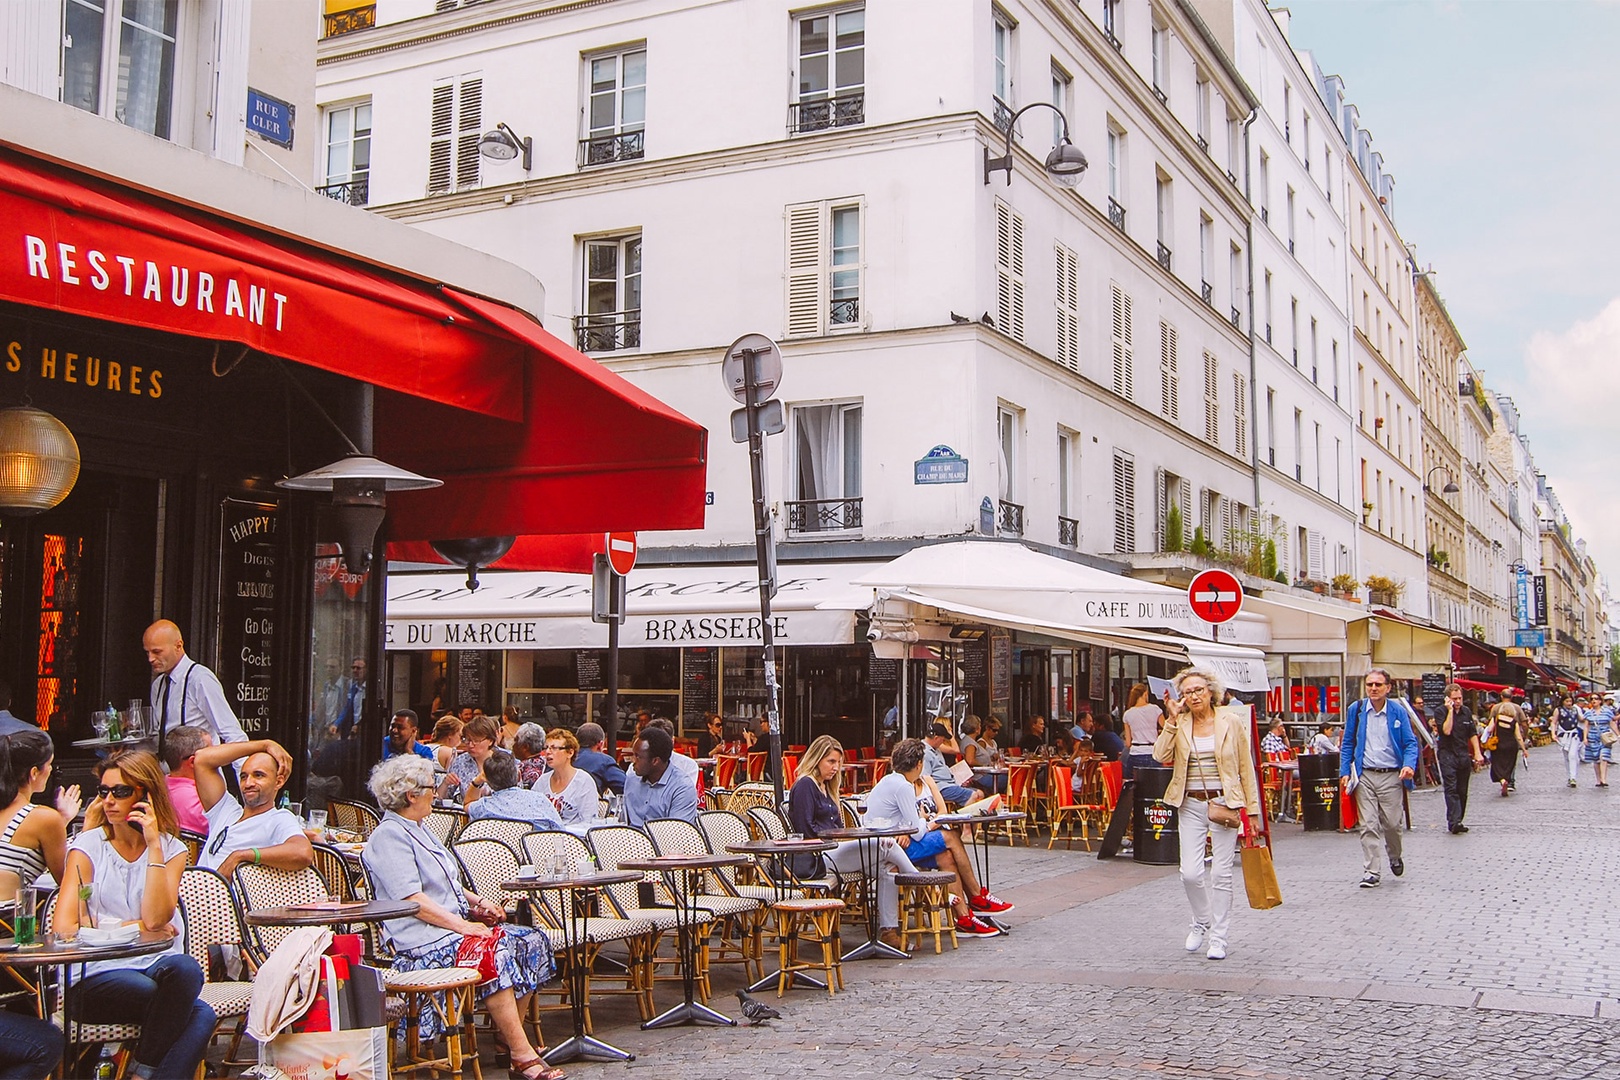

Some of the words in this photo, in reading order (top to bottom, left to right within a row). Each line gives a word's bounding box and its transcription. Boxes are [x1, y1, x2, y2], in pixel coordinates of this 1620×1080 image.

[255, 99, 279, 118] RUE
[252, 114, 280, 135] CLER
[25, 234, 287, 331] RESTAURANT
[5, 341, 22, 373] S
[41, 348, 163, 399] HEURES
[229, 517, 269, 543] HAPPY
[1536, 578, 1545, 618] HOTEL
[1085, 601, 1129, 618] CAFE
[1138, 603, 1154, 618] DU
[407, 624, 432, 644] DU
[445, 622, 537, 645] MARCHE
[645, 616, 789, 642] BRASSERE
[239, 718, 261, 732] INS
[1144, 807, 1173, 817] Havana
[1323, 799, 1333, 812] 7
[1149, 816, 1167, 824] Club
[1152, 824, 1164, 841] 7
